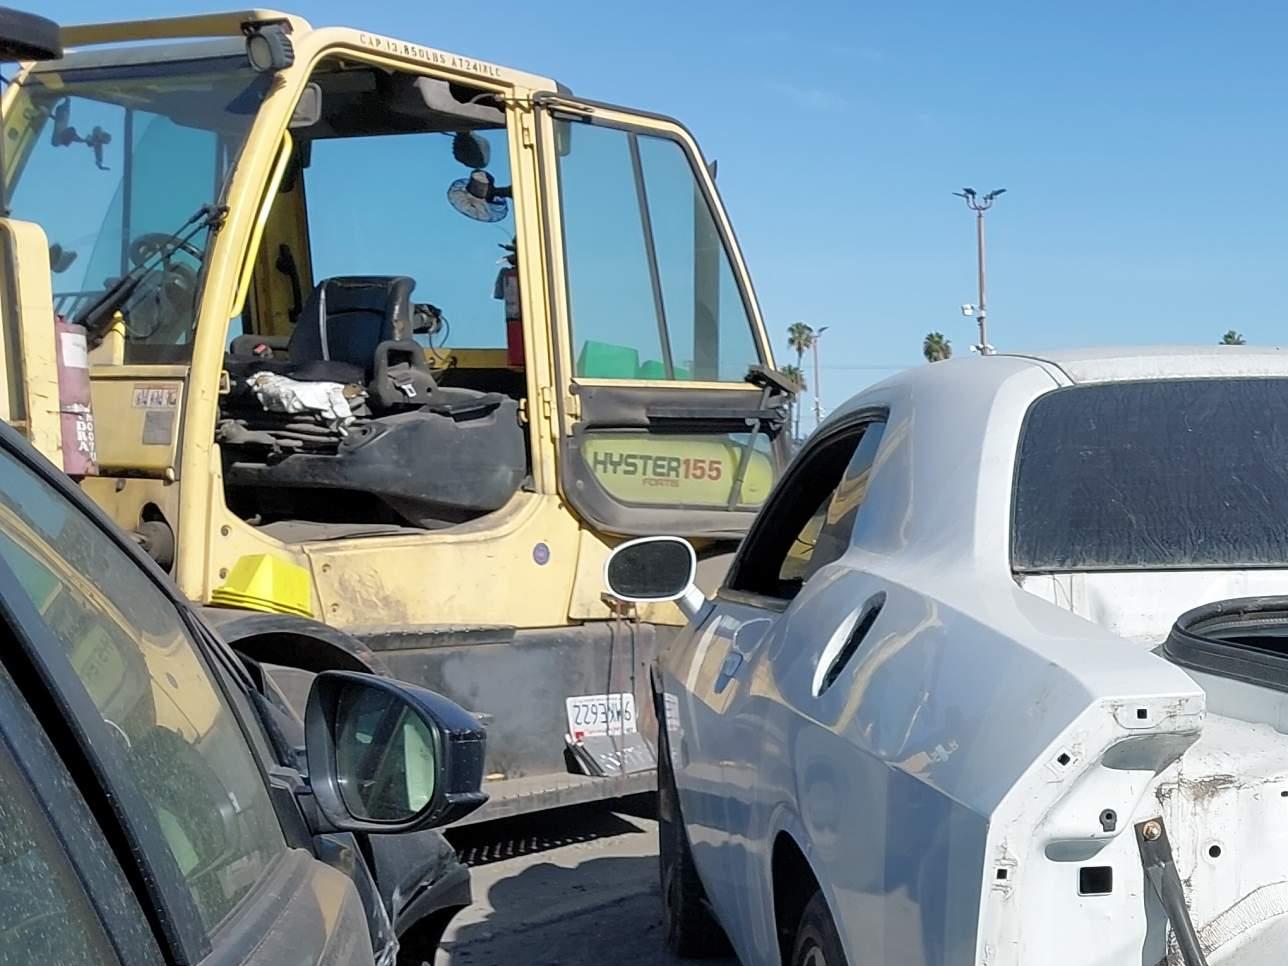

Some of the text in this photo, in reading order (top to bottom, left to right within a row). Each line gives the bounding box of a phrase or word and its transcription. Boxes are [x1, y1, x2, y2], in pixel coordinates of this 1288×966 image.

[359, 33, 383, 48] CAP
[594, 452, 722, 481] HYSTER 155
